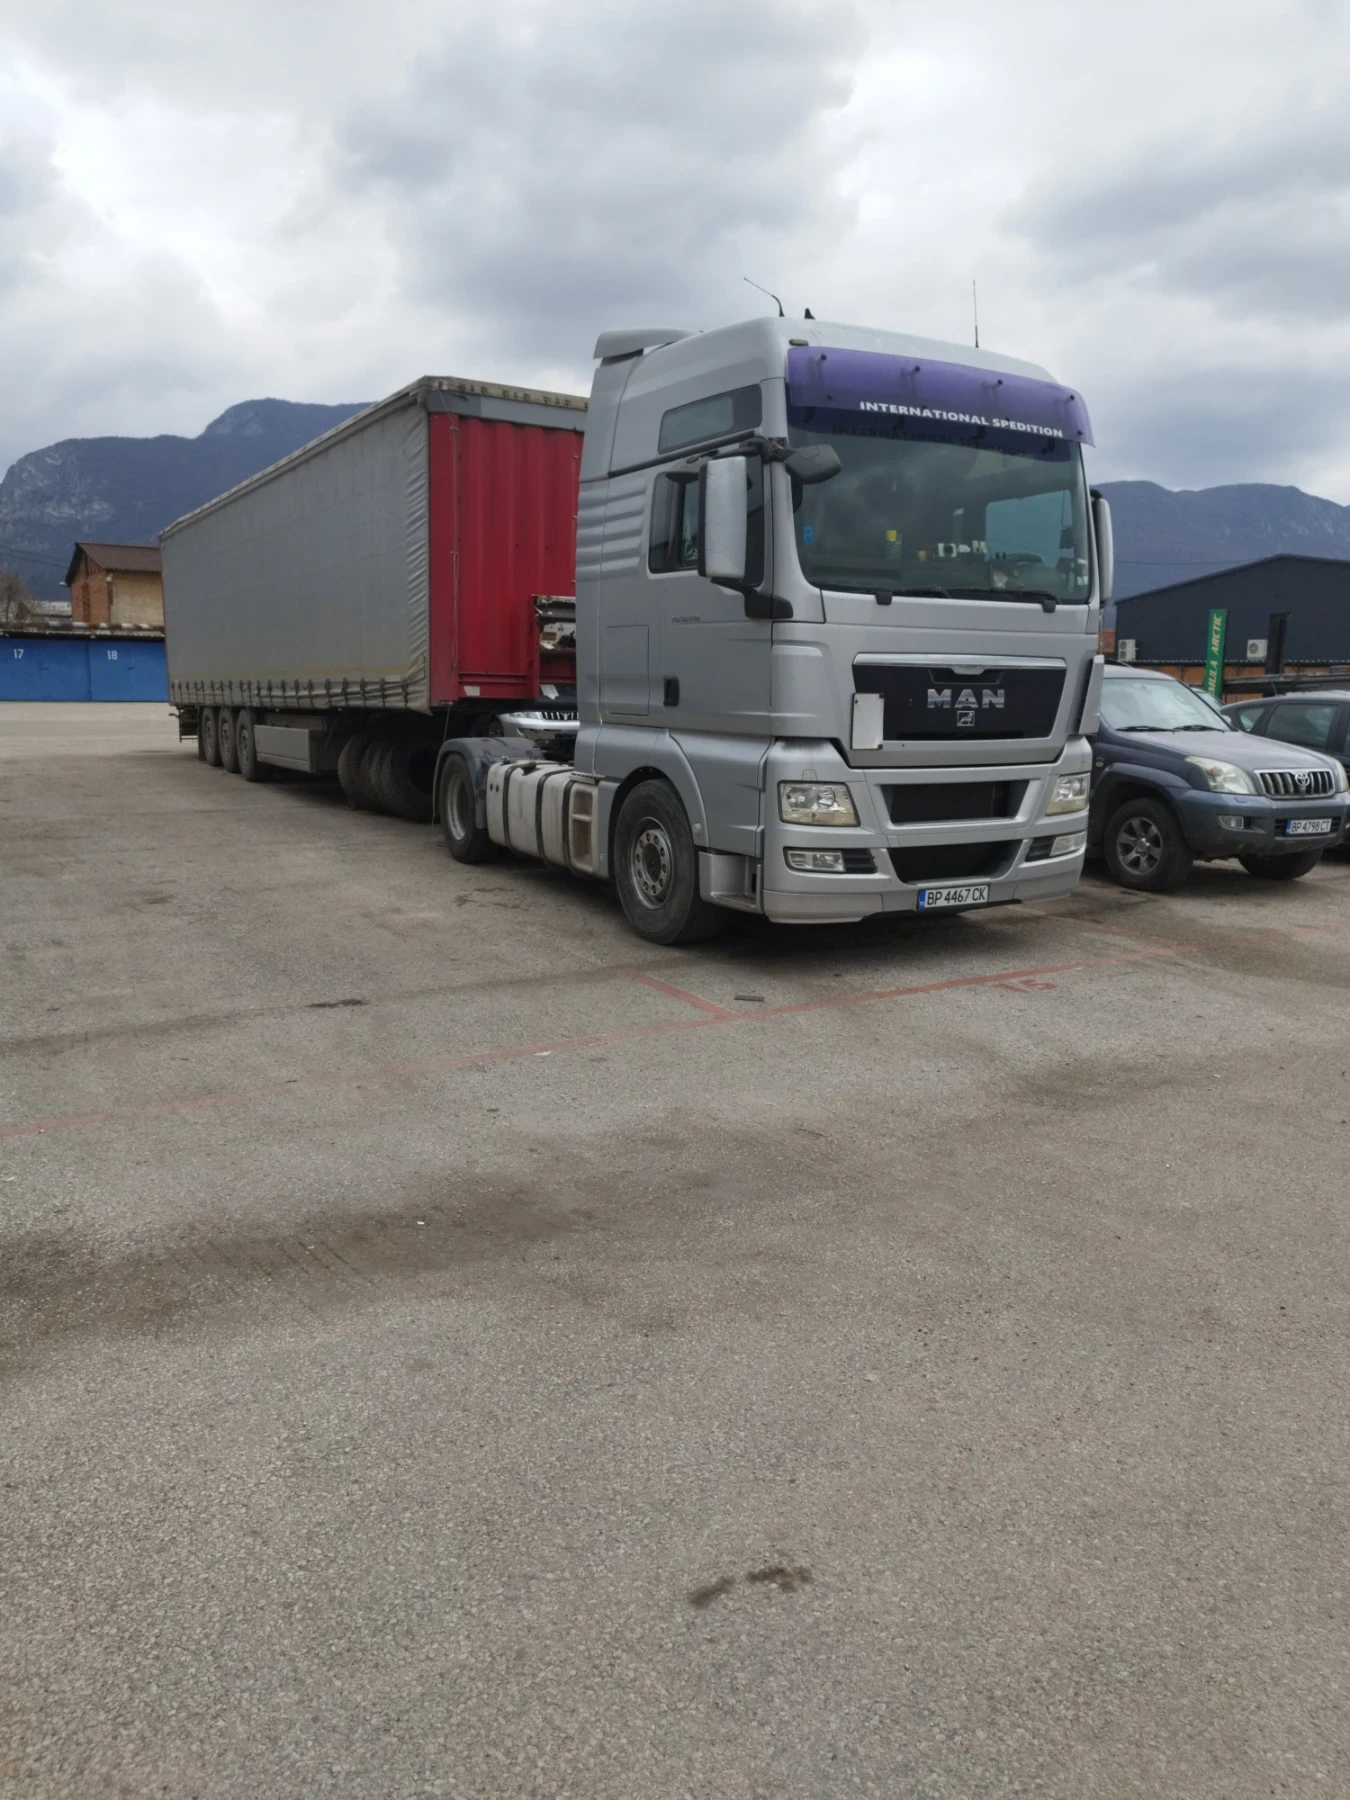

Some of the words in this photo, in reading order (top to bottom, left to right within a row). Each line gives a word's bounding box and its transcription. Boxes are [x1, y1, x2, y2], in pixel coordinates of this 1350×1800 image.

[859, 400, 989, 426] INTERNATIONAL
[992, 418, 1063, 438] SPEDITION
[1211, 614, 1222, 656] ARCTIC
[13, 648, 24, 659] 17
[107, 649, 118, 660] 18
[927, 688, 1005, 708] MAN
[1291, 821, 1302, 833] BP
[1320, 820, 1330, 831] CT
[927, 891, 943, 906] BP
[944, 888, 971, 904] 4467
[972, 886, 987, 902] CK
